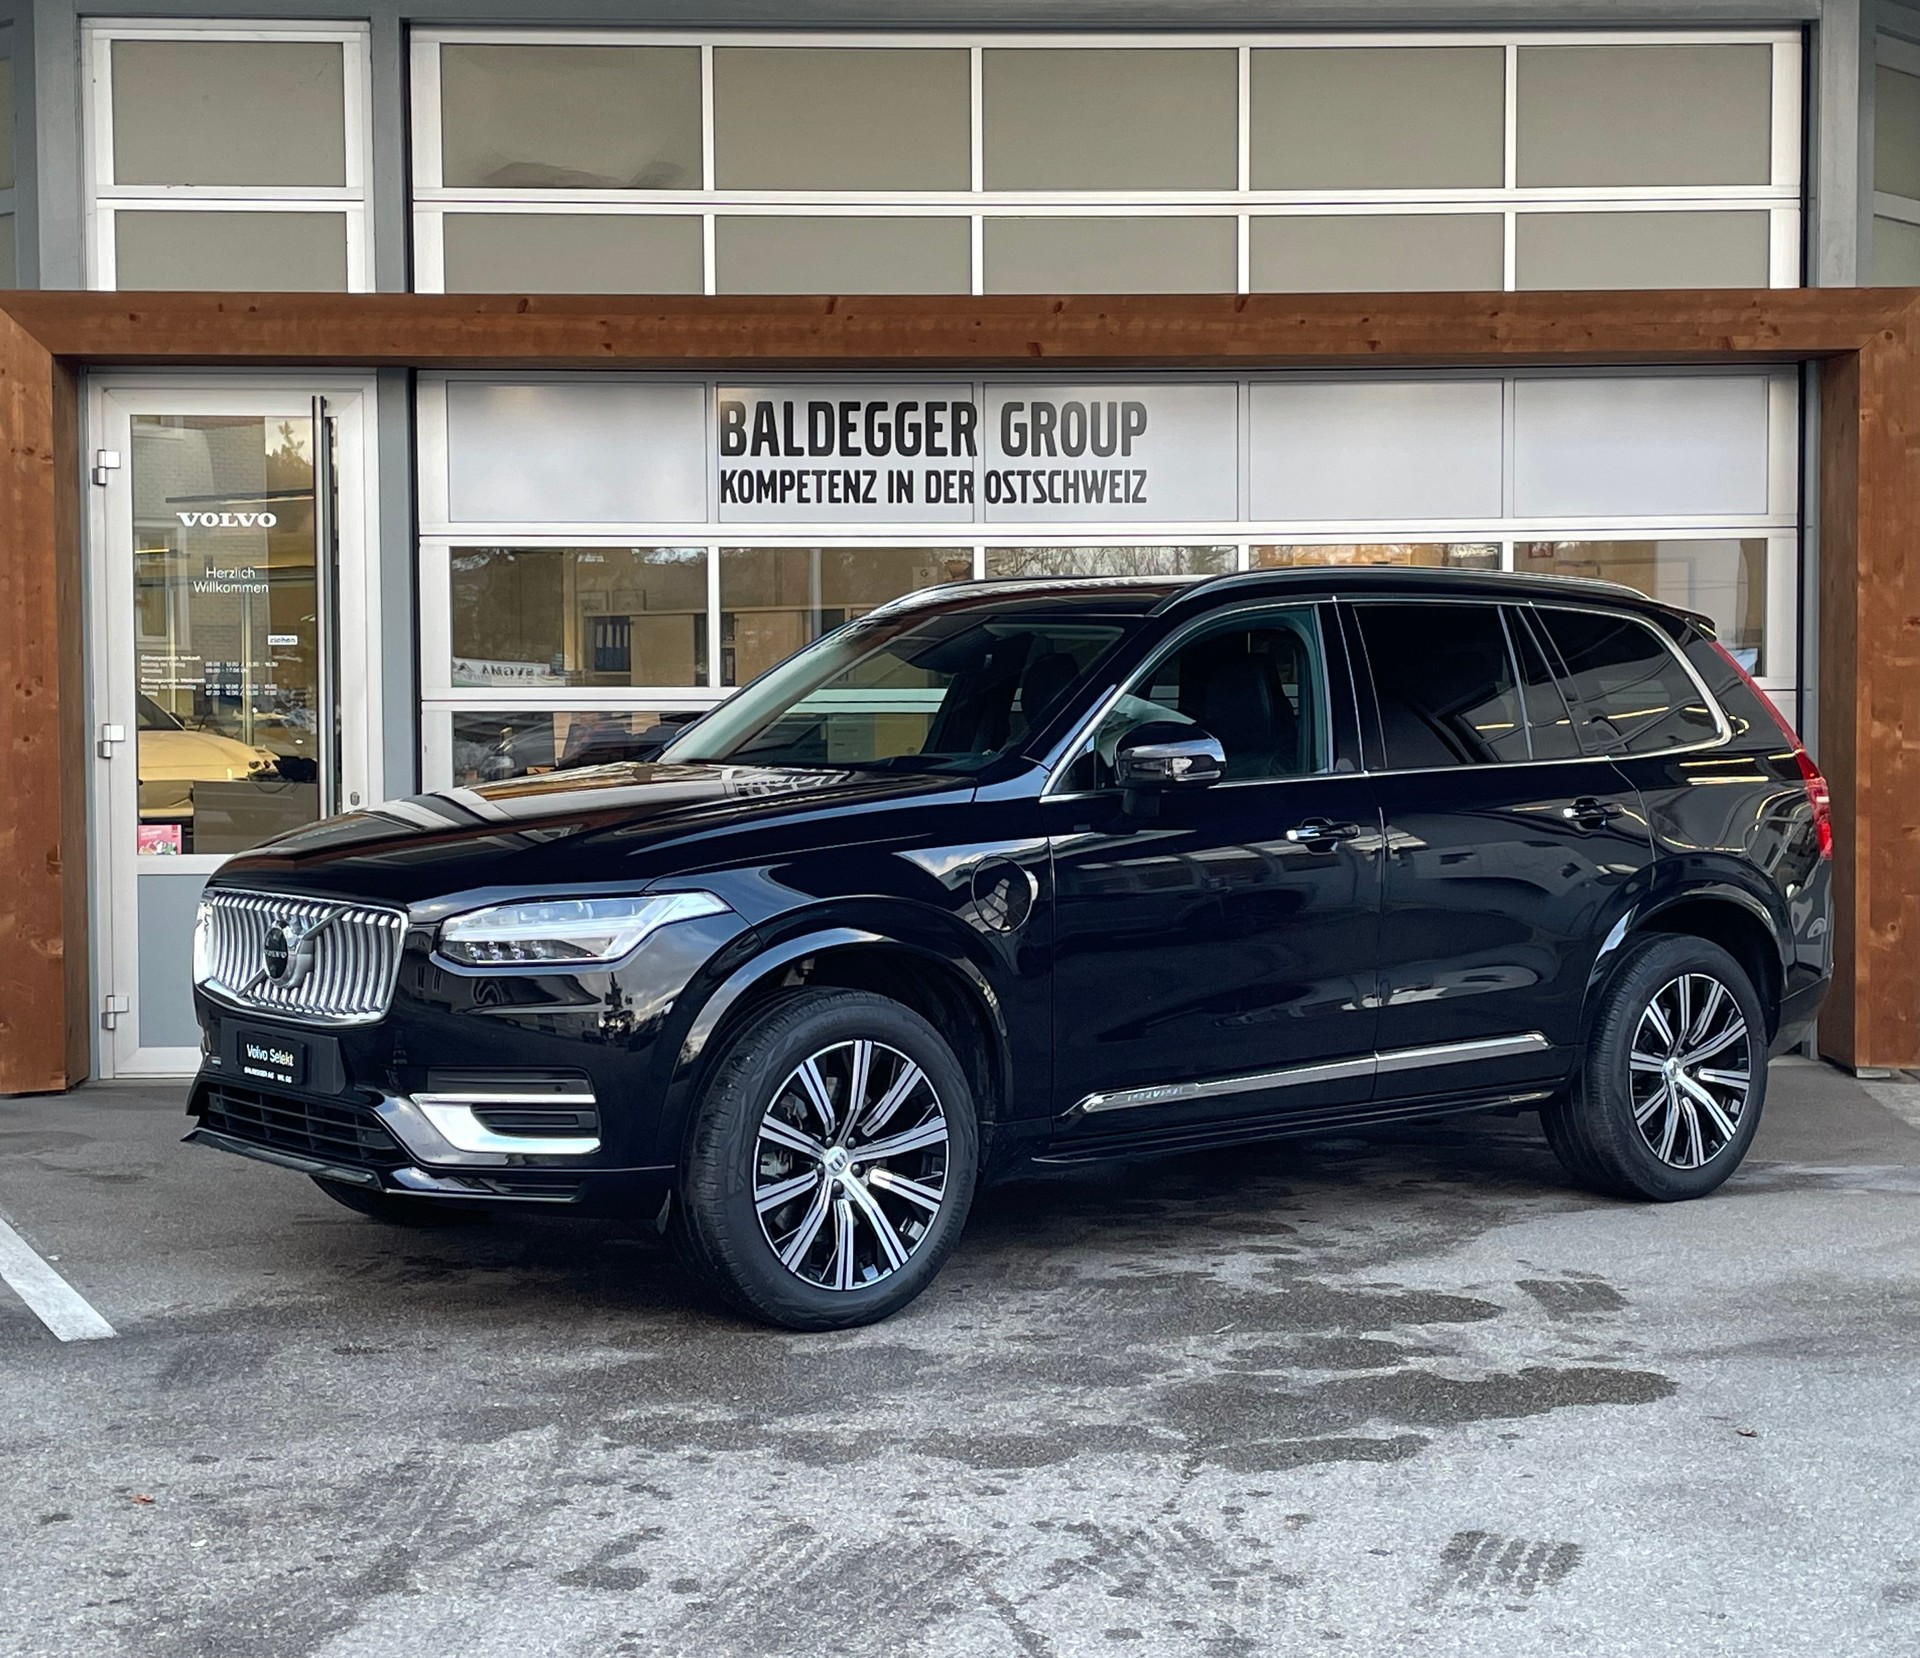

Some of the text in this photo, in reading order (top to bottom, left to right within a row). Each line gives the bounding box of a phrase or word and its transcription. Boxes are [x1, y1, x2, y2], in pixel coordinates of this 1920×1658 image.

[720, 401, 1148, 457] BALDEGGER GROUP
[720, 470, 1148, 504] KOMPETENZ IN DER OSTSCHWEIZ
[176, 512, 277, 528] VOLVO
[206, 567, 256, 579] Herzlich
[193, 581, 269, 594] Willkommen
[246, 1043, 294, 1067] Volvo Selekt
